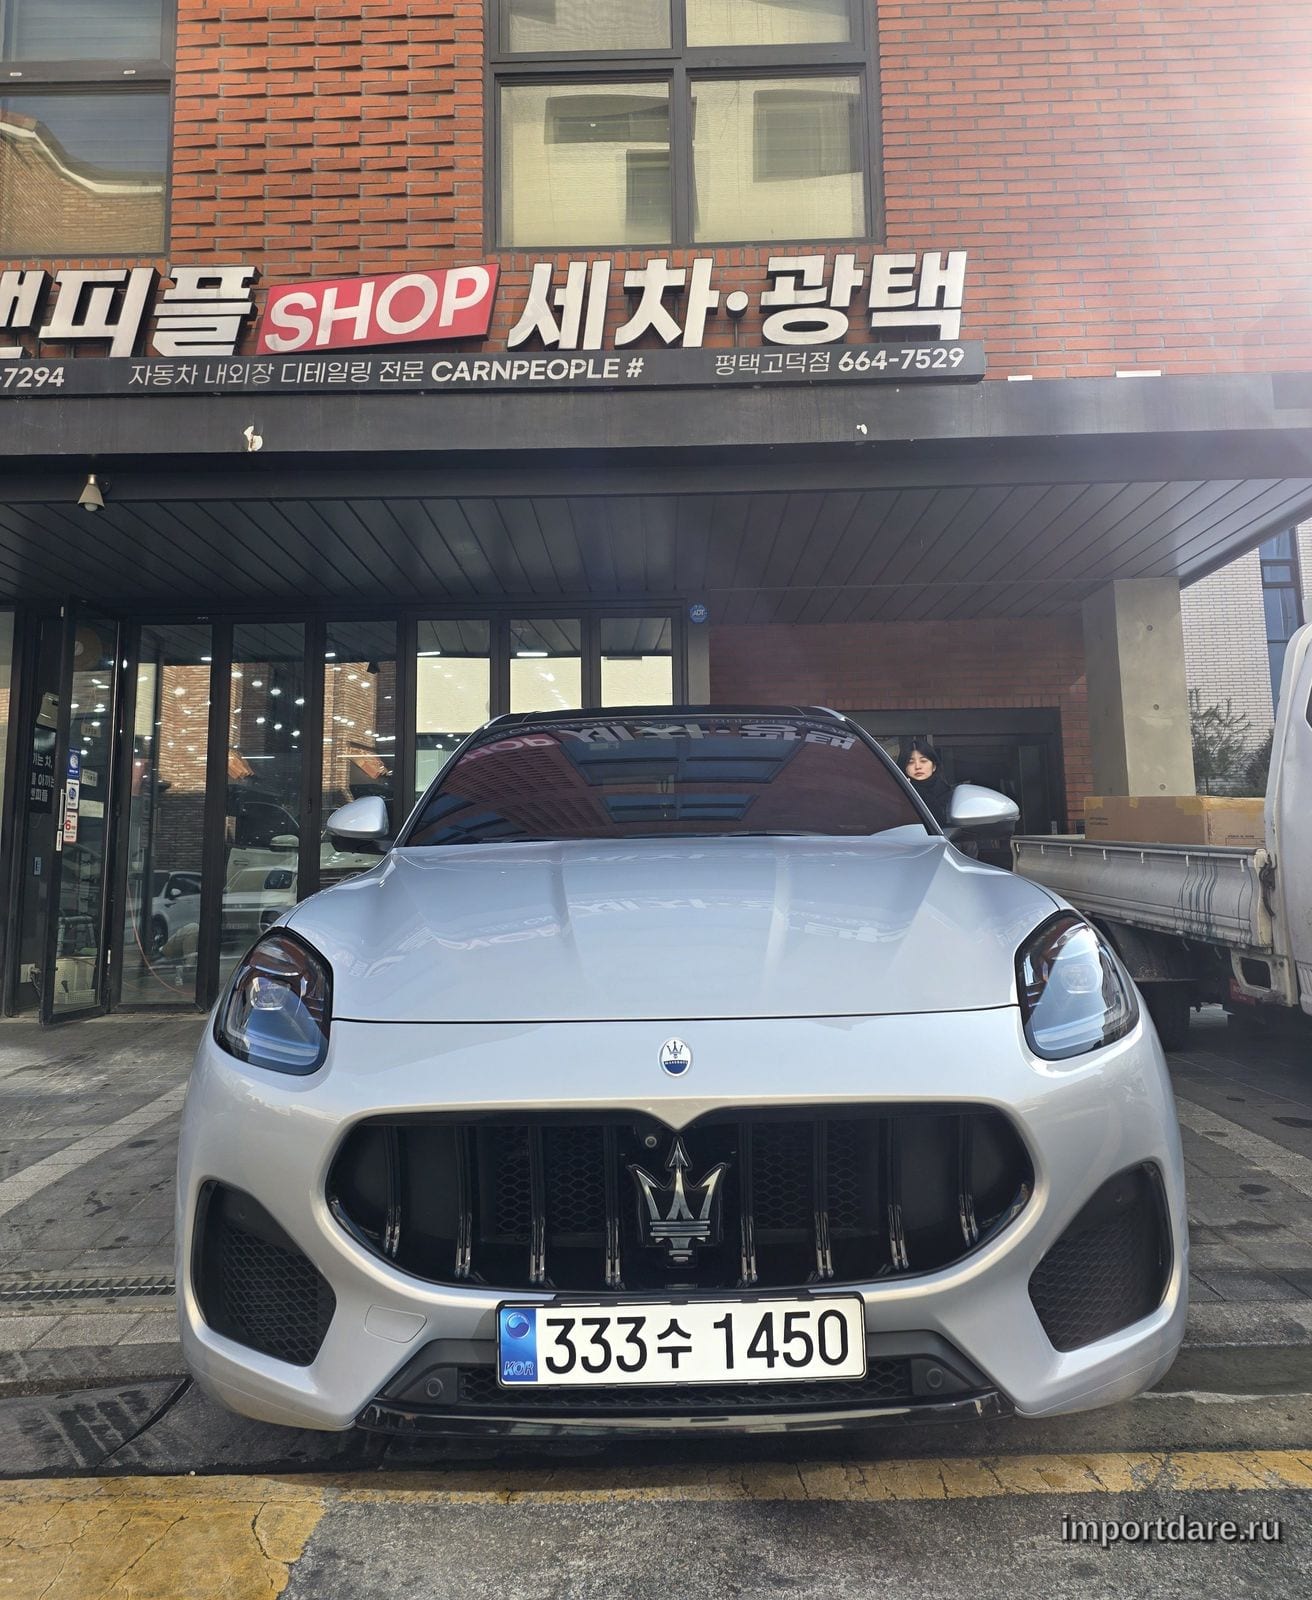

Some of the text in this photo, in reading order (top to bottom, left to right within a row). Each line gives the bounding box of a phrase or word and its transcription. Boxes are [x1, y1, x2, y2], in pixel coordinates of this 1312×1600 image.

[264, 264, 490, 352] SHOP
[128, 363, 198, 386] 자동차
[204, 362, 274, 384] 내외장
[281, 361, 372, 383] 디테일링
[379, 360, 424, 382] 전문
[431, 358, 620, 382] CARNPEOPLE
[715, 347, 965, 376] 평택고덕점 664-7529
[545, 1309, 848, 1375] 333수 1450
[503, 1360, 535, 1376] KOR
